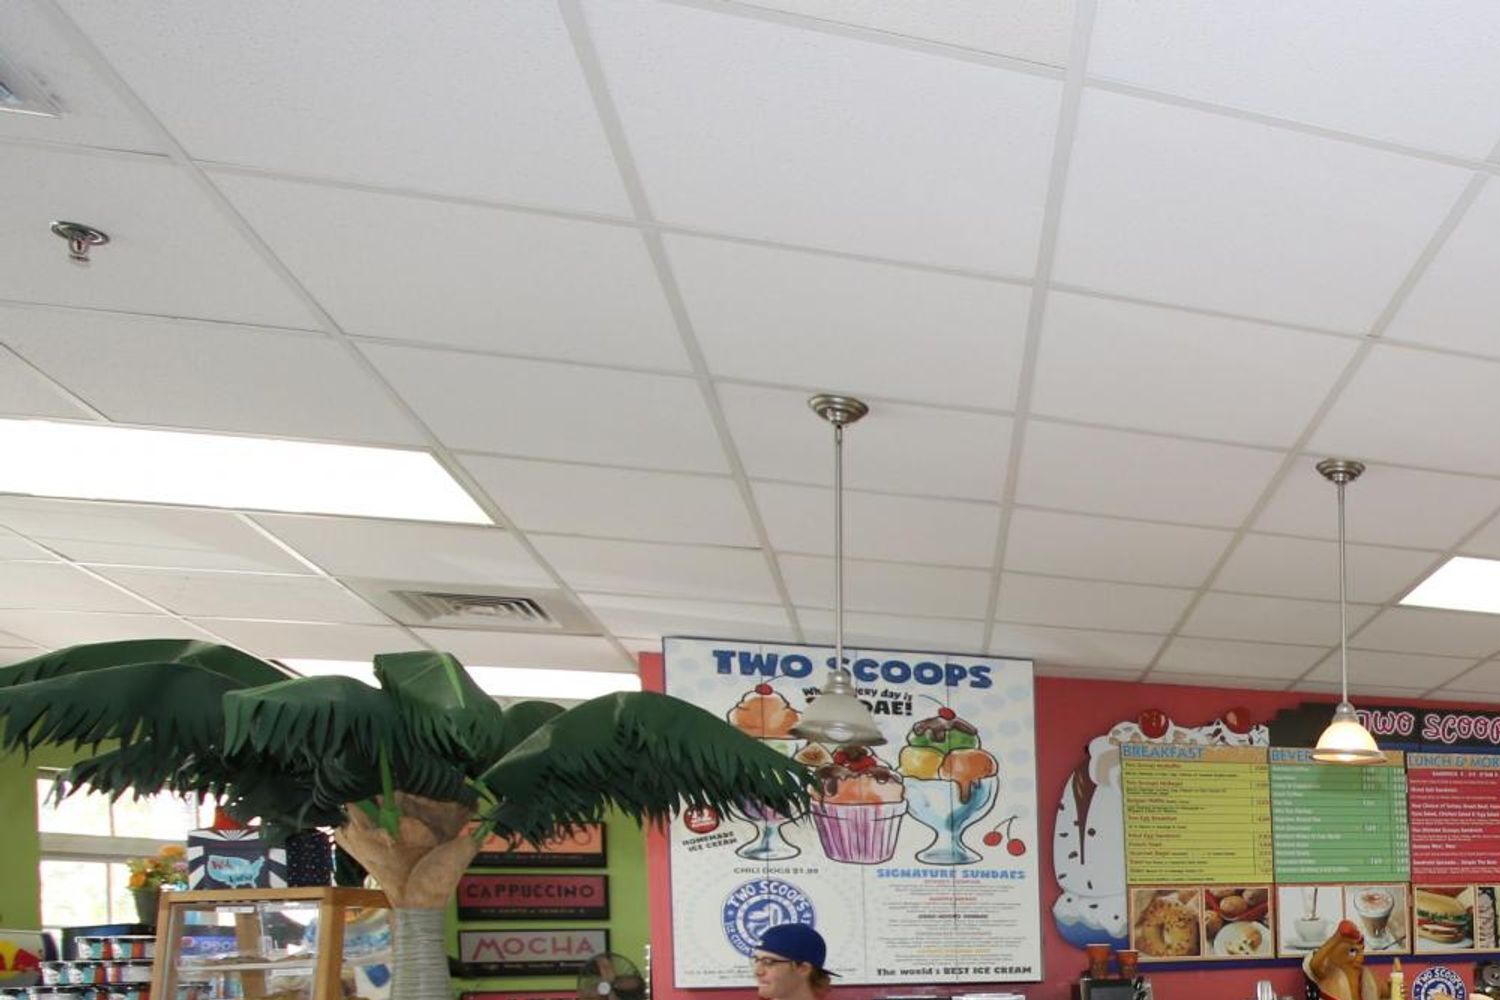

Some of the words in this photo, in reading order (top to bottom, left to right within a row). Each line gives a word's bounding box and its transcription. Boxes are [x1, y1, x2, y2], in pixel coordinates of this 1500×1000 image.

[713, 650, 812, 678] TWO
[880, 689, 902, 700] day
[1356, 710, 1415, 736] TWO
[1123, 745, 1204, 758] BREAKFAST
[1272, 751, 1314, 762] BEVER
[1409, 755, 1452, 767] LUNCH
[1456, 757, 1466, 767] &
[876, 868, 956, 879] SIGNATURE
[961, 869, 1026, 880] SUNDAES
[466, 883, 595, 898] CAPPUCCINO
[728, 884, 757, 908] TWO
[759, 880, 811, 912] SCOOPS
[473, 936, 596, 960] MOCHA
[876, 967, 896, 977] The
[943, 966, 969, 975] BEST
[973, 966, 990, 975] ICE
[994, 966, 1032, 975] CREAM
